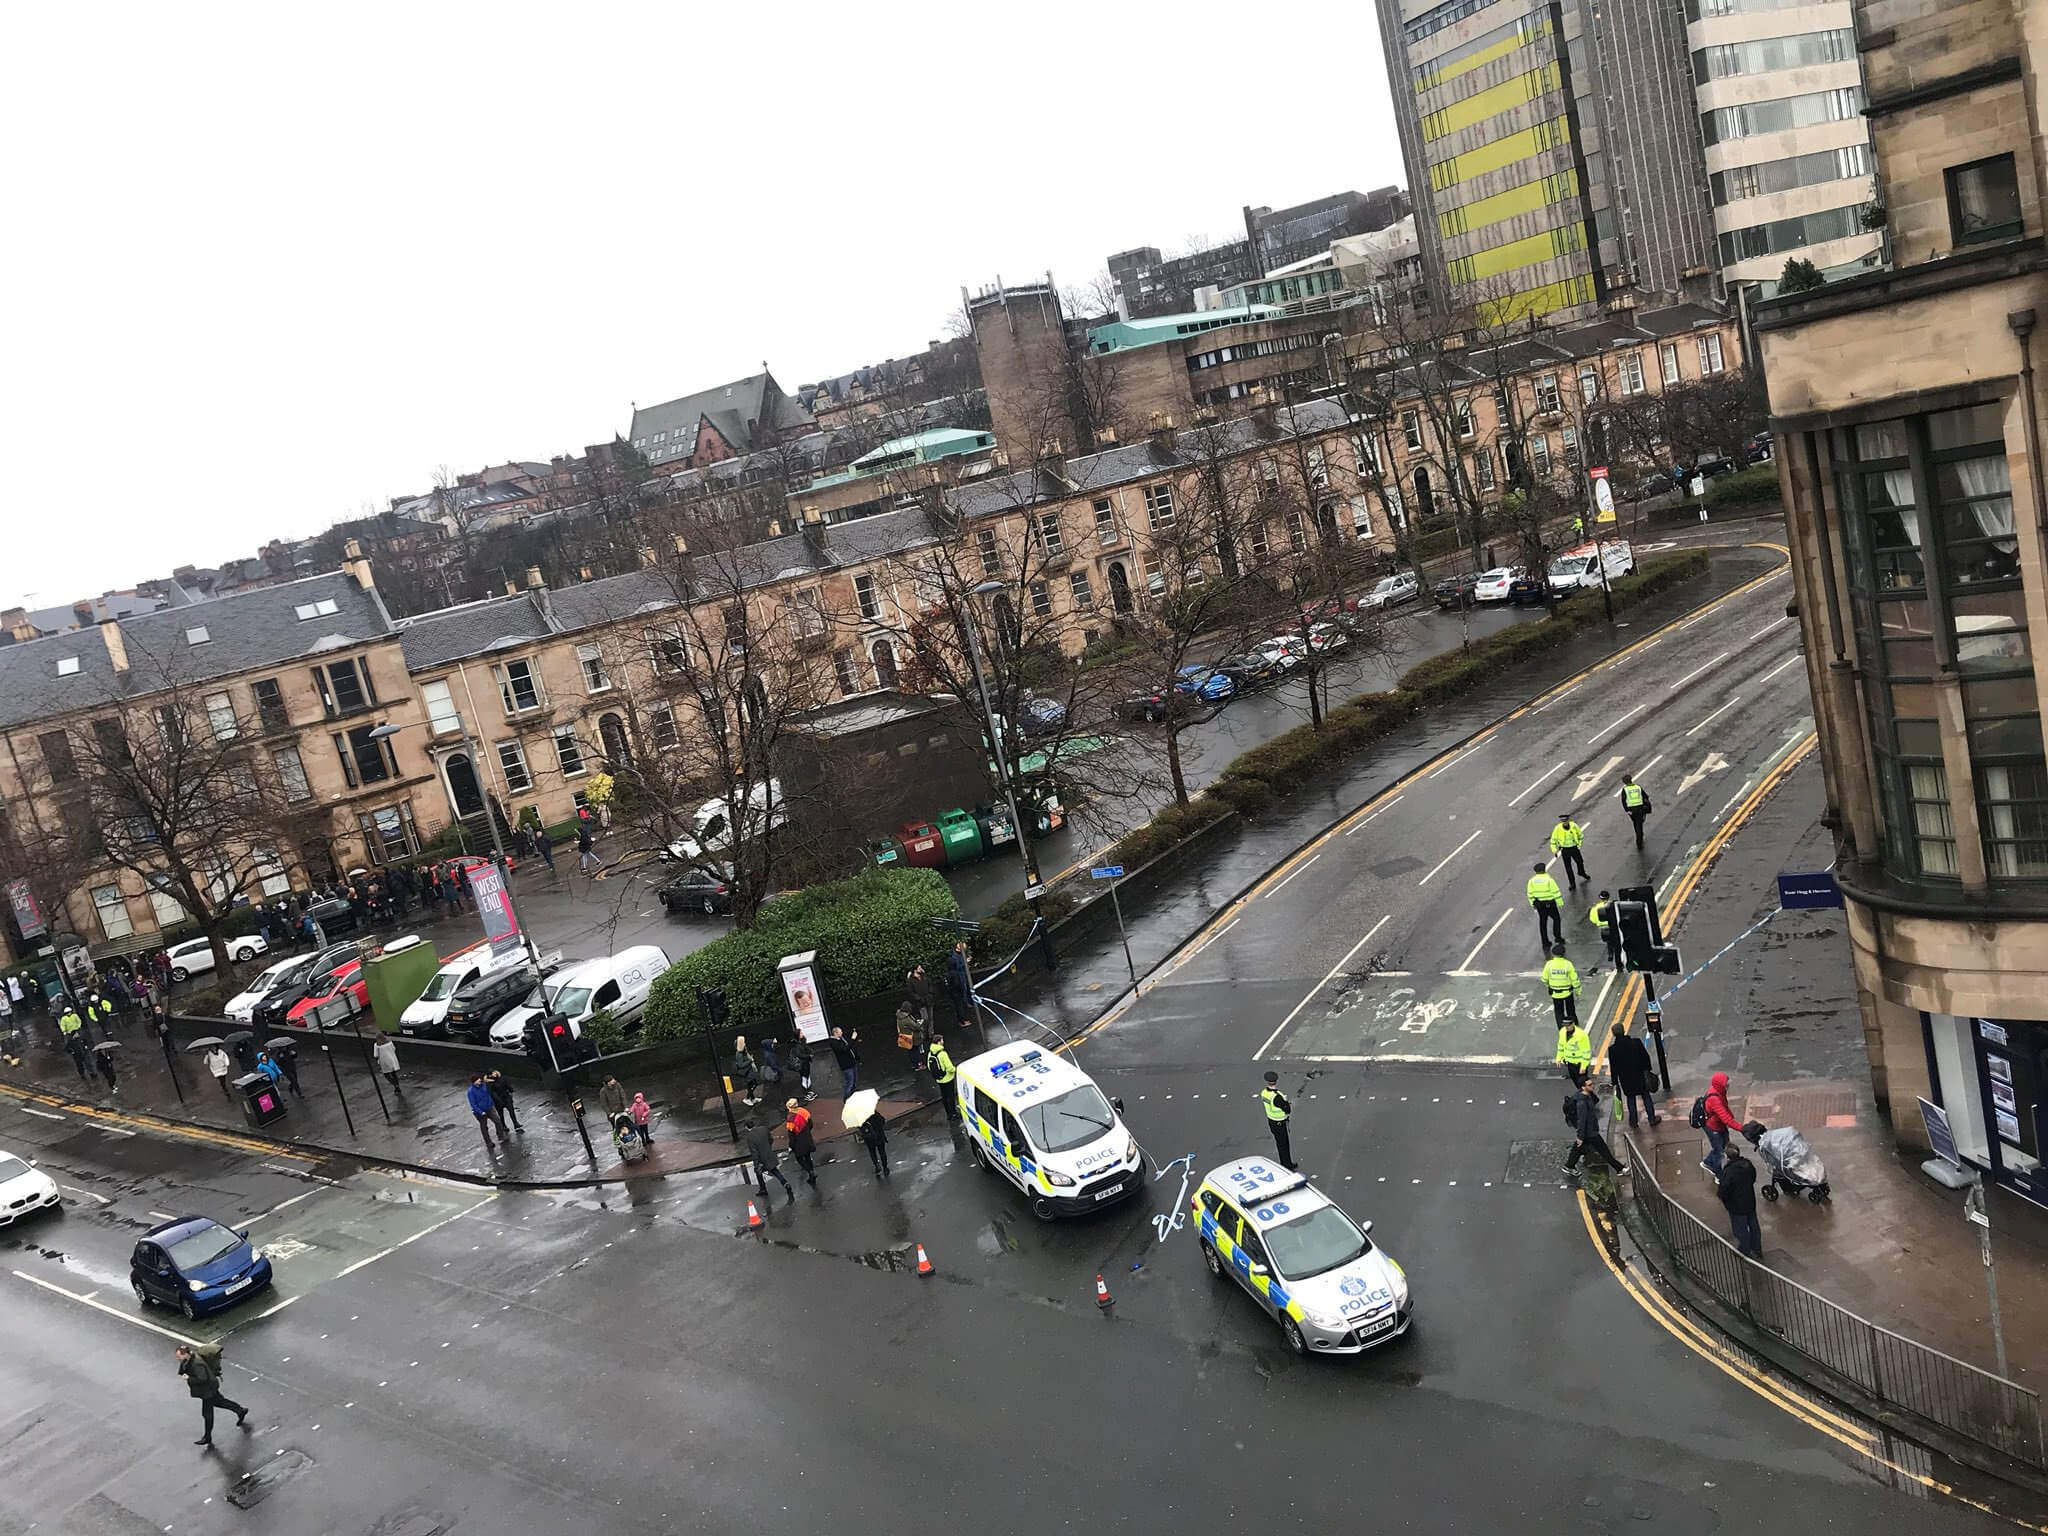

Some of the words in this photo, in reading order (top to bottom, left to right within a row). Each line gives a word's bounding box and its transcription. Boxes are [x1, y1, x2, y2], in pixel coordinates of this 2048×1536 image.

[475, 874, 500, 896] WEST
[481, 892, 502, 912] END
[1076, 1147, 1117, 1169] POLICE
[1340, 1288, 1390, 1316] POLICE
